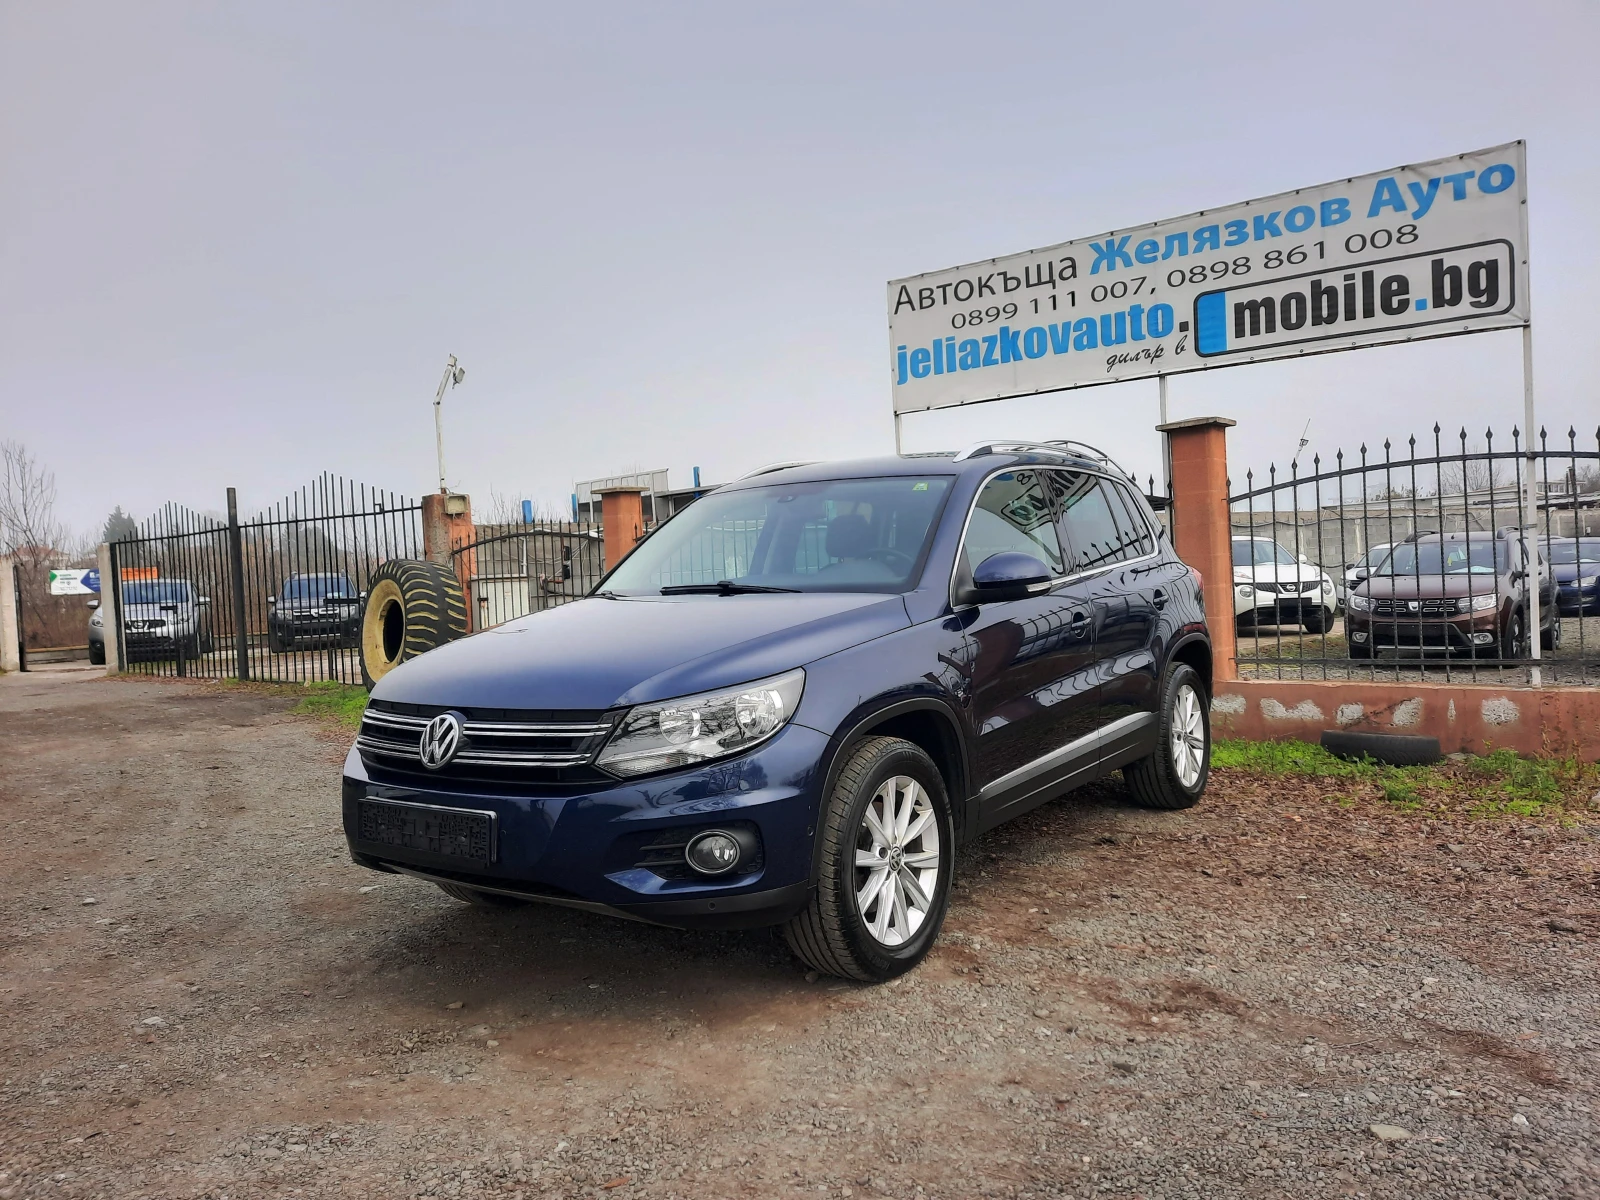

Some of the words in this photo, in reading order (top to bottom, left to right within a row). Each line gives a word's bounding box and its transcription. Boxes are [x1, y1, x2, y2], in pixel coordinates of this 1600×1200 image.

[893, 256, 1077, 315] Автокъща
[1089, 197, 1351, 275] Желязков
[1367, 163, 1516, 220] Ауто
[951, 302, 1018, 329] 0899
[1030, 290, 1076, 314] 111
[1091, 276, 1156, 302] 007,
[1166, 256, 1252, 288] 0898
[1263, 240, 1325, 269] 861
[1344, 223, 1419, 253] 008
[1234, 258, 1499, 339] mobile.bg
[1106, 343, 1166, 373] дилър
[420, 714, 459, 769] VW
